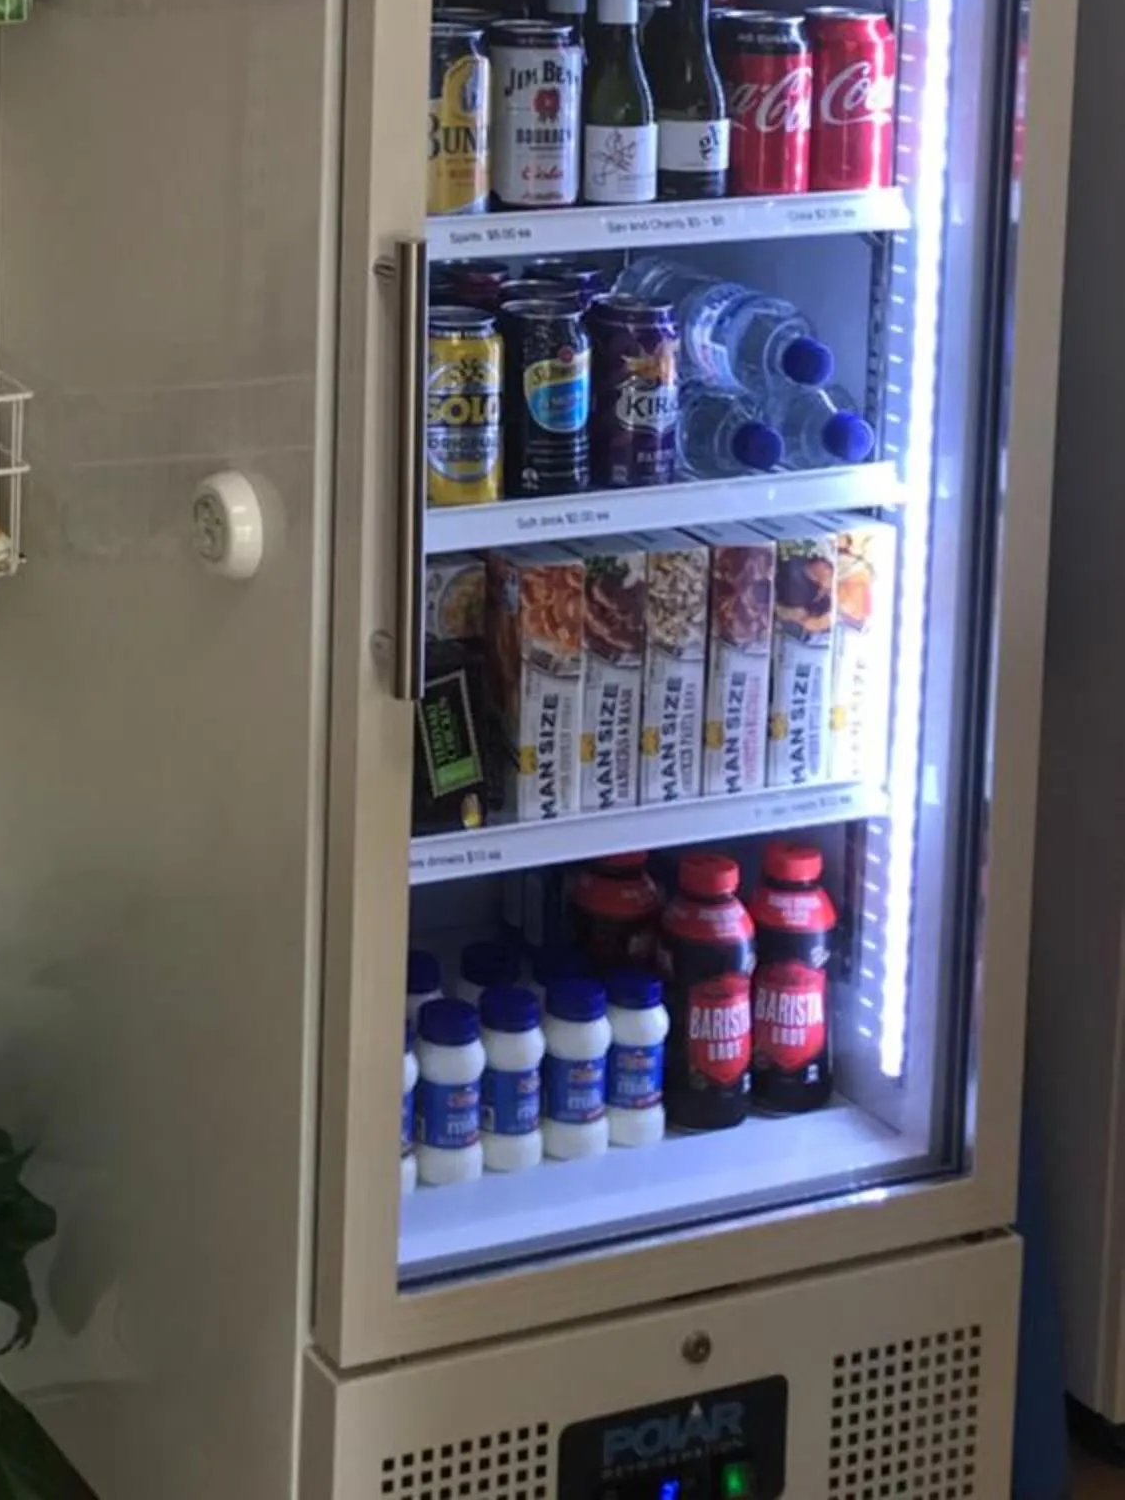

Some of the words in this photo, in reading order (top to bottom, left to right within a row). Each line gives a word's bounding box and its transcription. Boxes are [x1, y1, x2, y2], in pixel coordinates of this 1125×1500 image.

[505, 66, 538, 97] JIM
[598, 682, 620, 743] SIZE
[661, 676, 684, 737] SIZE
[726, 671, 749, 730] SIZE
[790, 663, 813, 721] SIZE
[538, 692, 559, 755] SIZE
[596, 749, 616, 810] MAN
[660, 743, 678, 801] MAN
[725, 737, 743, 794] MAN
[790, 727, 807, 785] MAN
[539, 760, 558, 820] MAN
[602, 1400, 744, 1468] POLAR
